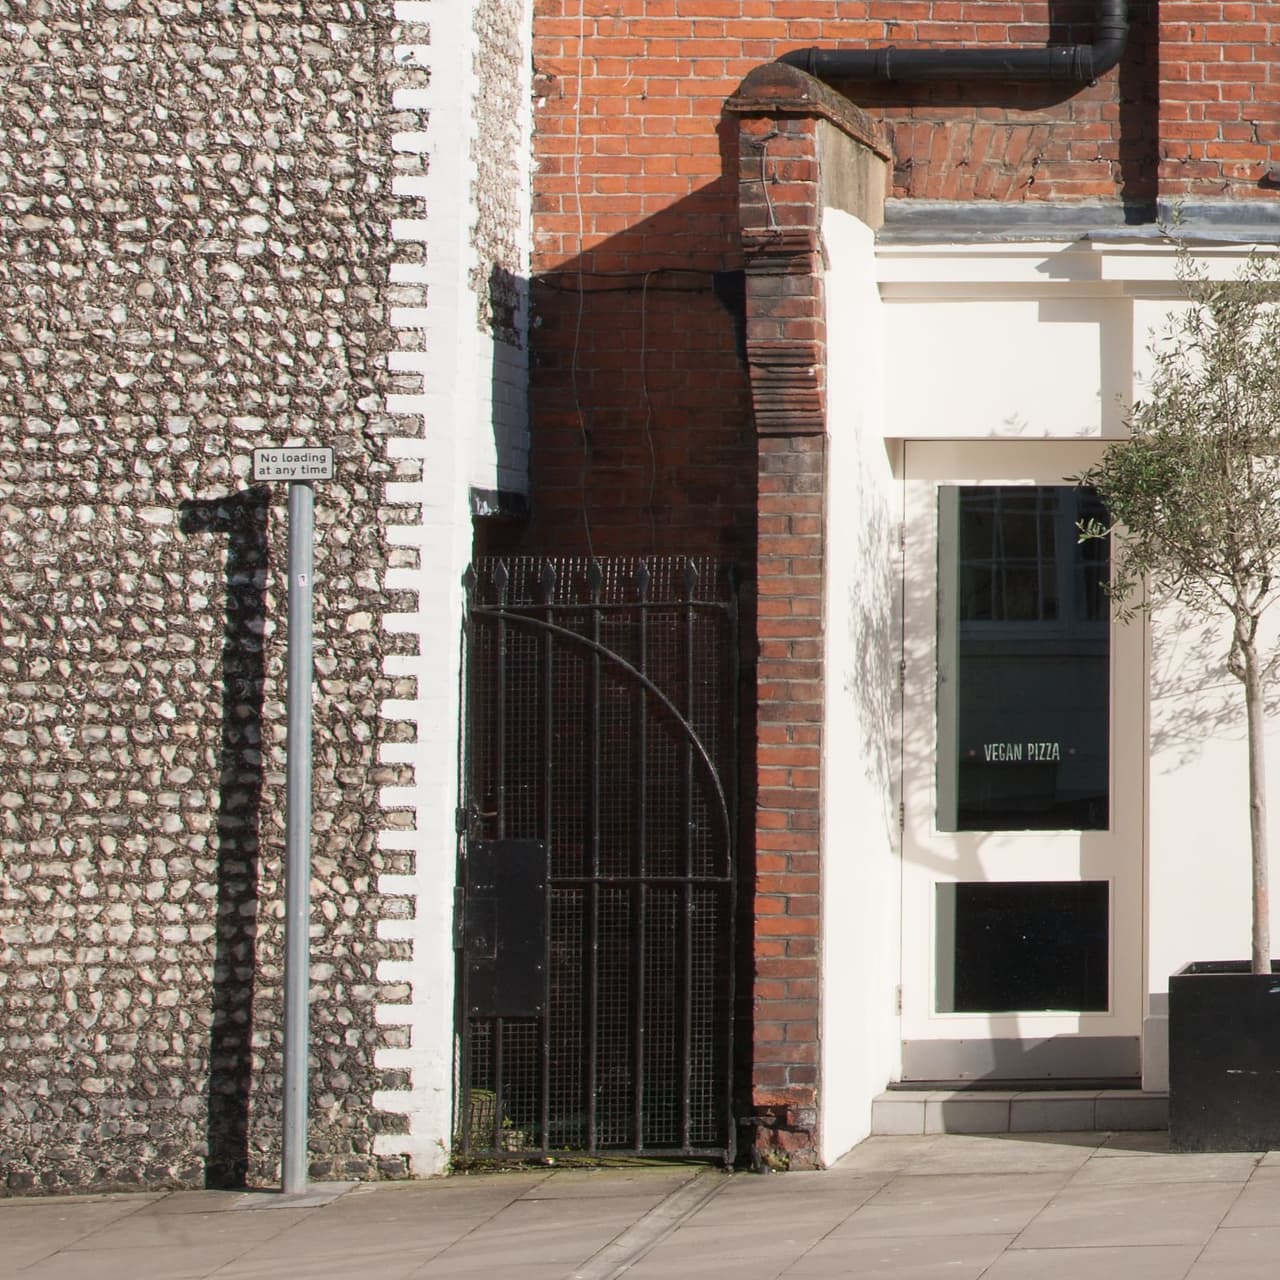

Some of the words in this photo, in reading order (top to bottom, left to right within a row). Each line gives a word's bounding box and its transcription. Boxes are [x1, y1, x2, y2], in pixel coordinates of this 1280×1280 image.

[260, 453, 278, 463] No
[282, 452, 327, 464] loading
[259, 465, 272, 475] at
[275, 466, 297, 476] any
[301, 464, 328, 474] time
[984, 743, 1022, 761] VEGAN
[1027, 742, 1061, 761] PIZZA
